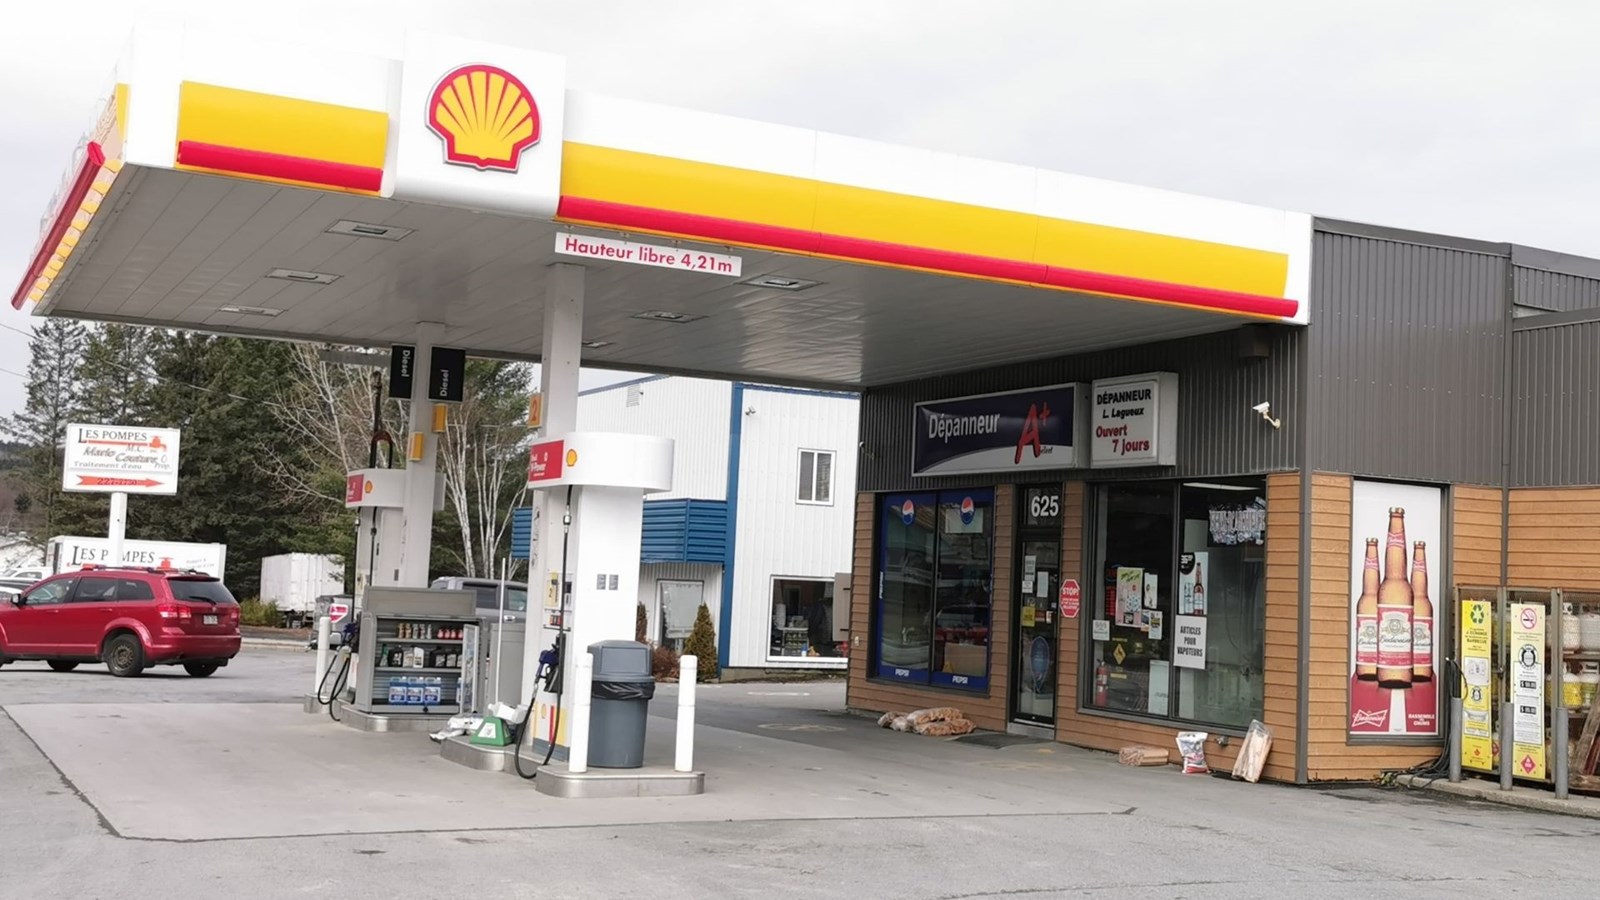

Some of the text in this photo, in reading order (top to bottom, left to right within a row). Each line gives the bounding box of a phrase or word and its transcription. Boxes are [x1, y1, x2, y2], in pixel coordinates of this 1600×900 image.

[565, 237, 733, 273] Hauteur libre 4,21m
[401, 350, 411, 378] Diesel
[440, 369, 450, 398] Diesel
[1096, 388, 1152, 406] DÉPANNEUR
[101, 430, 148, 442] POMPES
[928, 413, 1000, 443] Dépanneur
[1096, 423, 1128, 438] Ouvert
[1112, 438, 1150, 456] 7 jours
[1031, 495, 1059, 517] 625
[100, 548, 155, 564] PMPES
[1180, 625, 1202, 636] ARTICLES
[1184, 636, 1197, 646] POUR
[1177, 646, 1204, 658] VAPOTEURS
[952, 675, 969, 685] PEPSI
